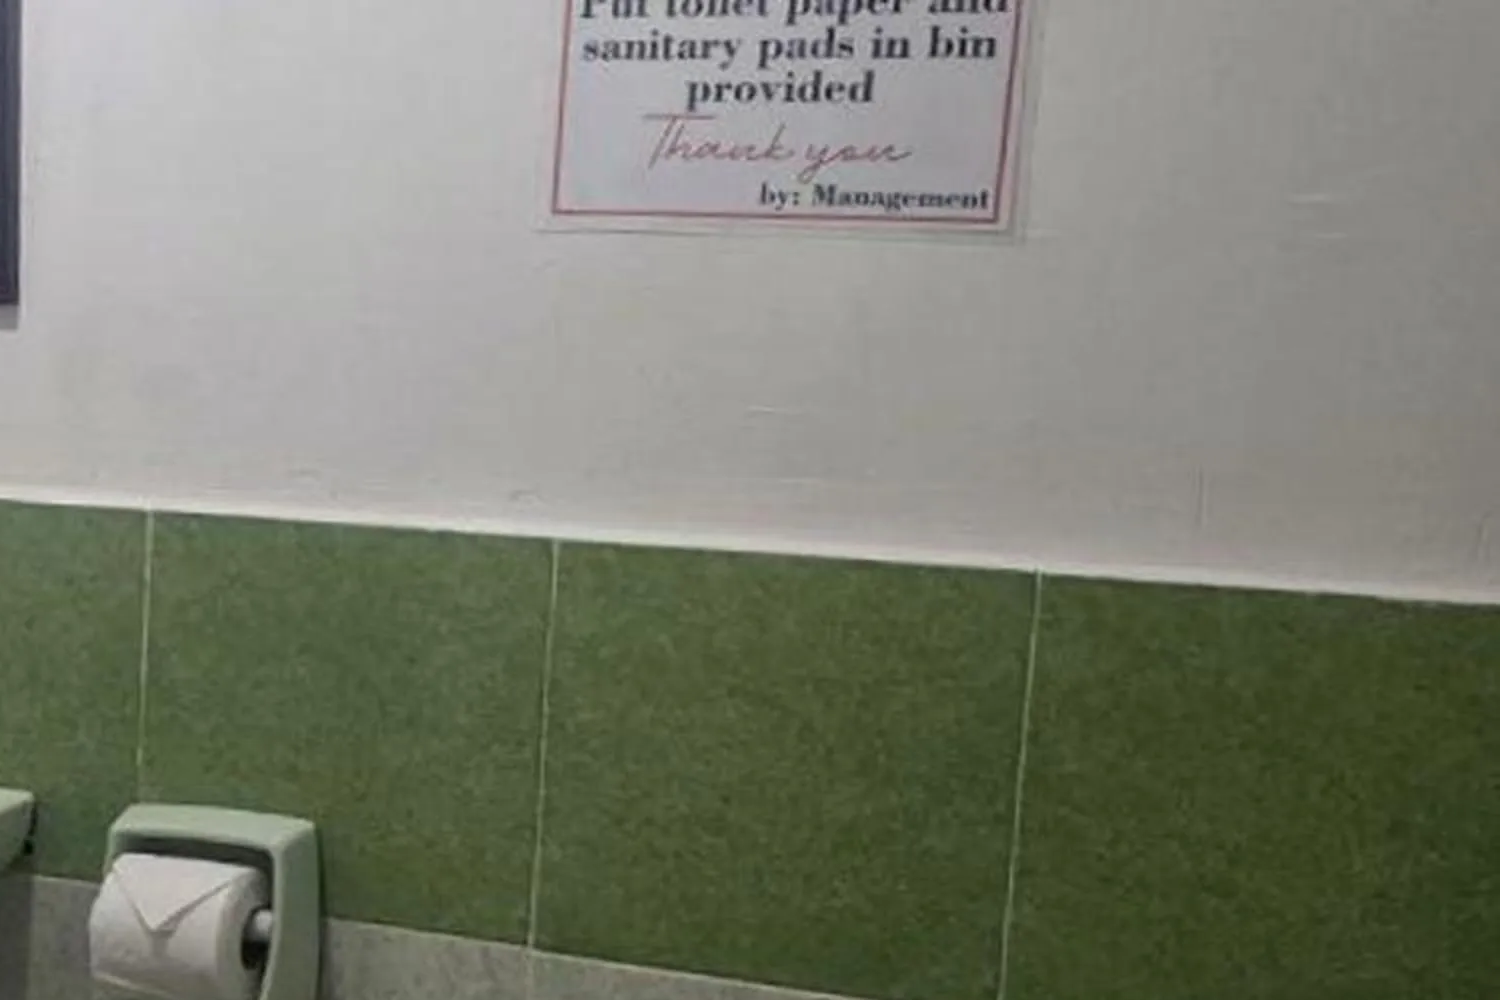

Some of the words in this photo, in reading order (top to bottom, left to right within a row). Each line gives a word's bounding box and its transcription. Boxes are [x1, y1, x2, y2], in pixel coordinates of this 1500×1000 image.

[582, 28, 743, 71] sanitary
[758, 25, 854, 70] pads
[872, 26, 910, 59] in
[930, 25, 997, 59] bin
[685, 69, 876, 112] provided
[642, 114, 795, 170] Thank
[798, 143, 913, 185] you
[759, 182, 799, 211] by:
[813, 183, 989, 213] Management
